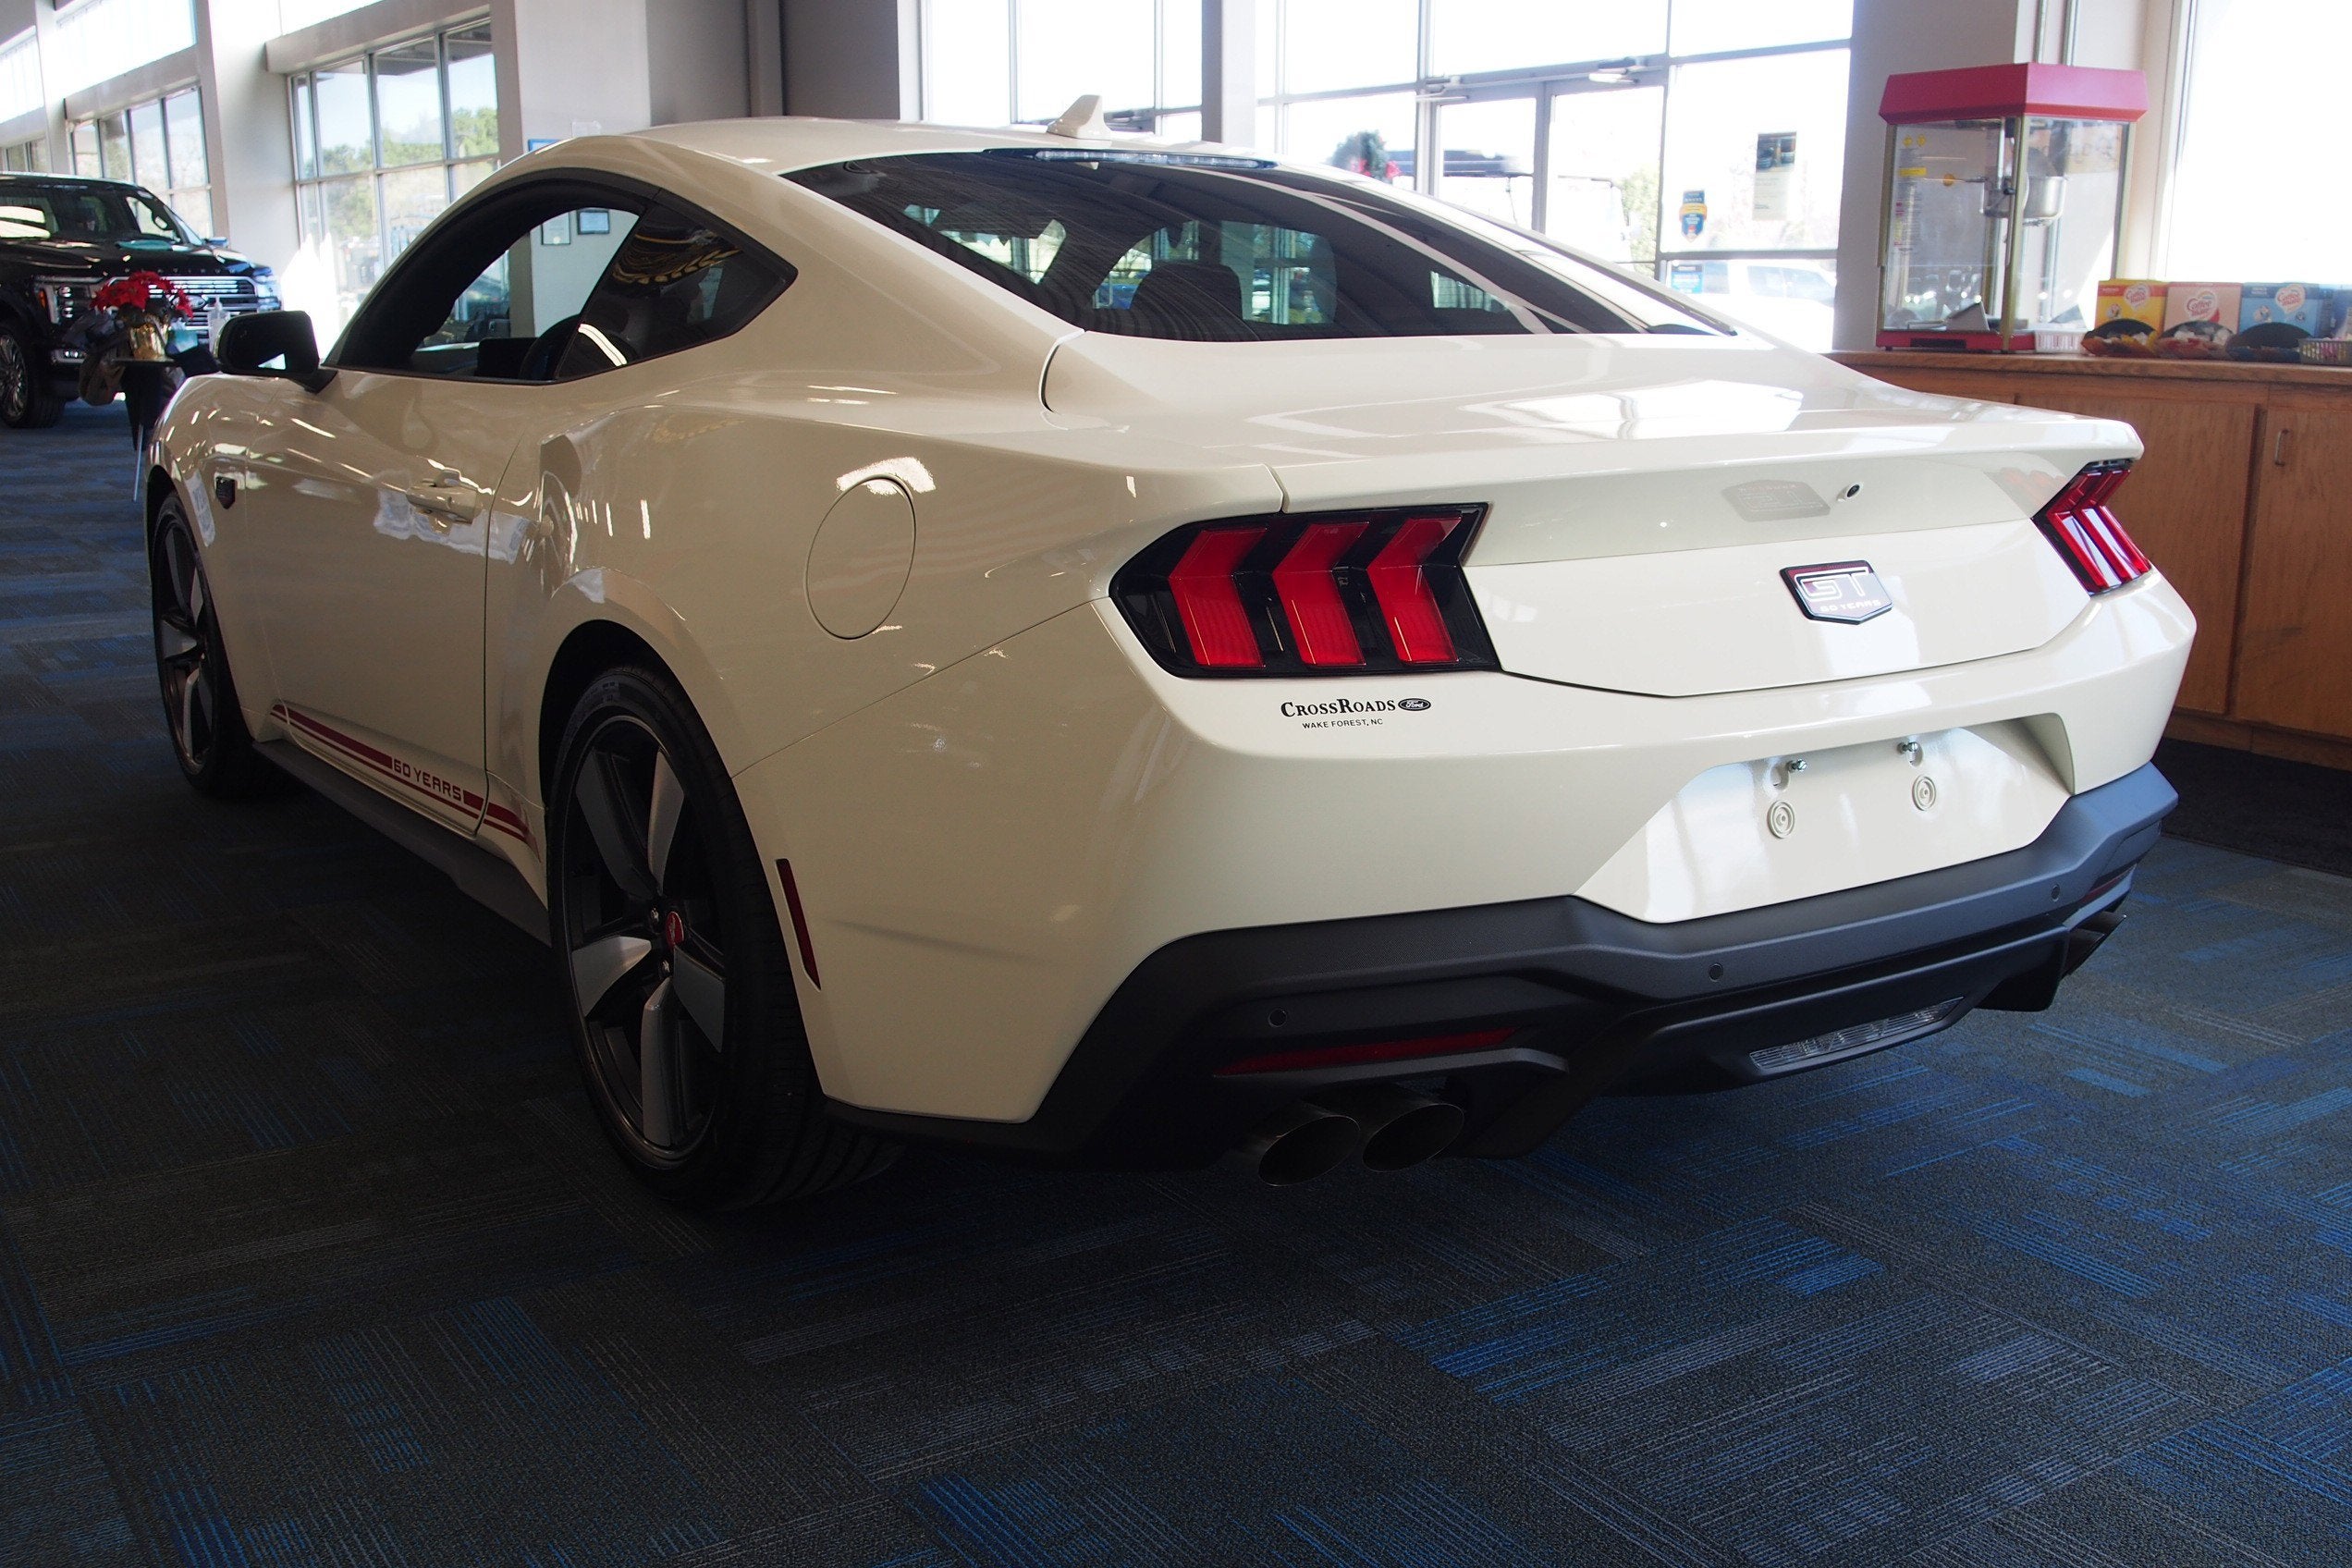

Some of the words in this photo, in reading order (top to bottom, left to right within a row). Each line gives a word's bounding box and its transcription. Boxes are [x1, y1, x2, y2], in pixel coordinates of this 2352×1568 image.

[1795, 567, 1869, 601] GT
[1302, 721, 1329, 729] WAKE
[1331, 718, 1369, 728] FOREST,
[1371, 717, 1384, 726] NC
[393, 758, 411, 778] 60
[413, 766, 461, 802] YEARS
